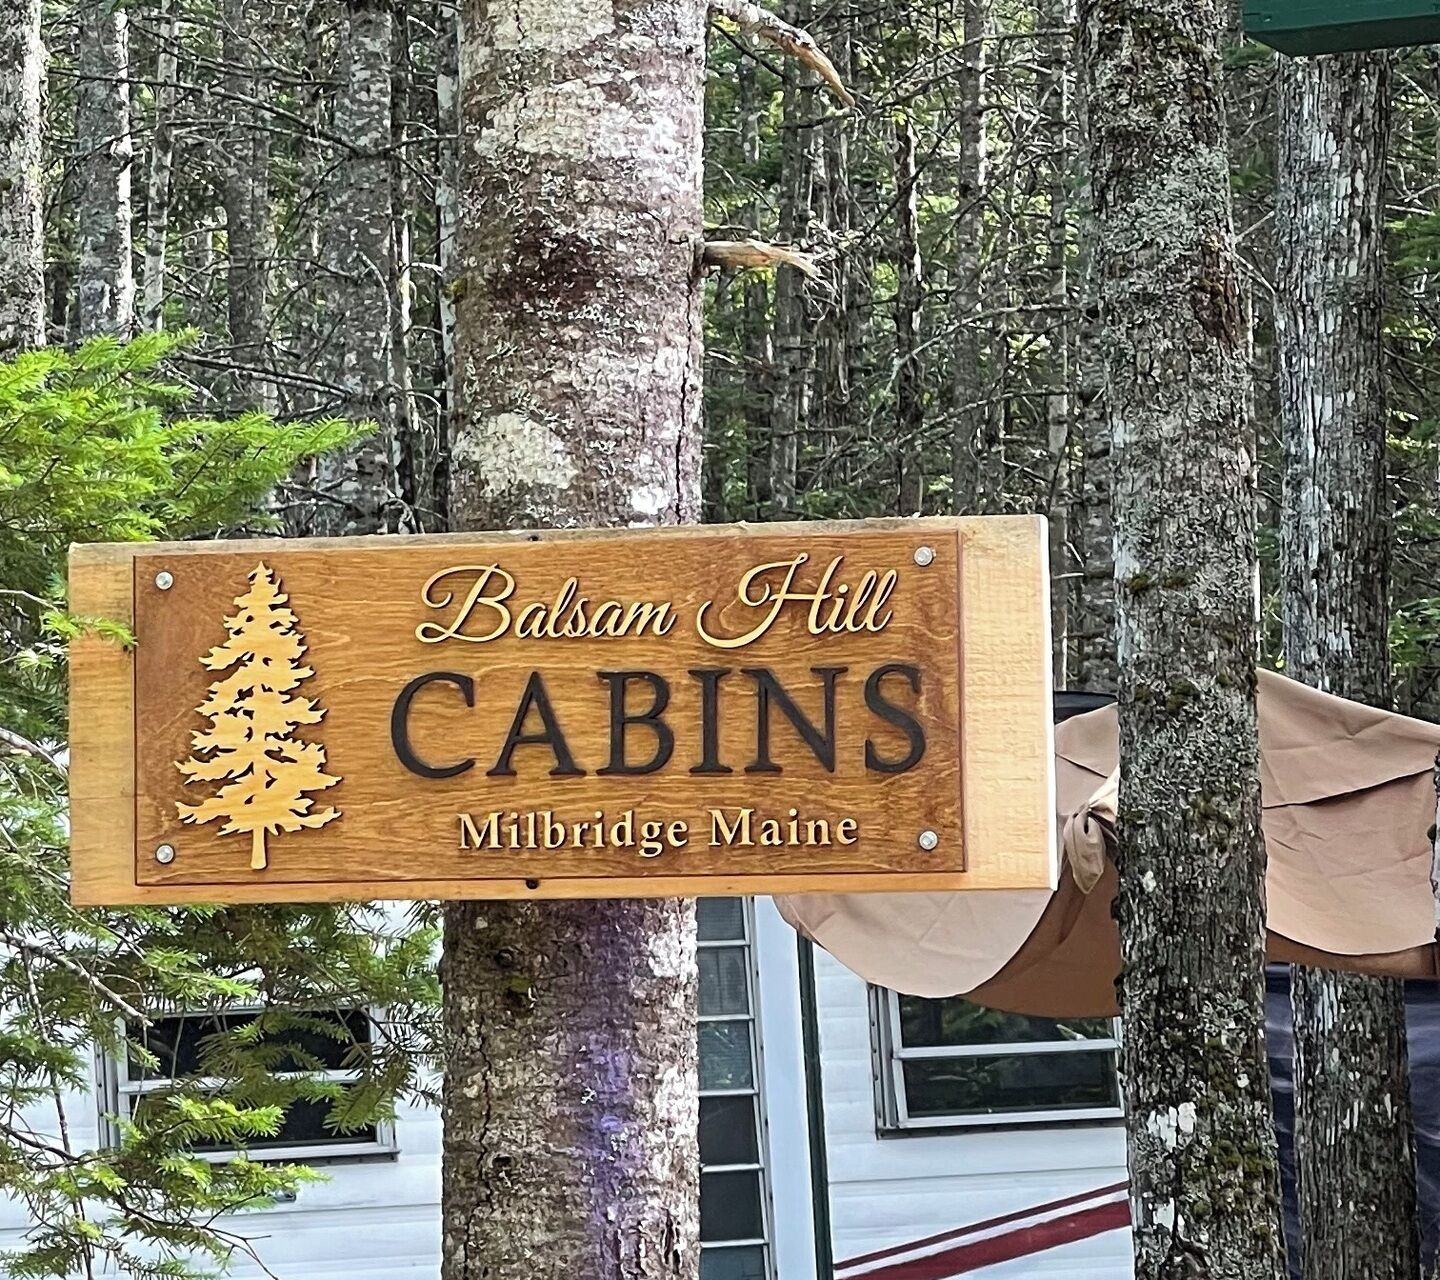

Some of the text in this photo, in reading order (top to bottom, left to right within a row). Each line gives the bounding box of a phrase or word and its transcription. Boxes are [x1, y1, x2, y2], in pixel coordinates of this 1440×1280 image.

[415, 552, 898, 649] Balsam Hill
[390, 662, 927, 779] CABINS
[458, 807, 859, 858] Milbridge Maine
